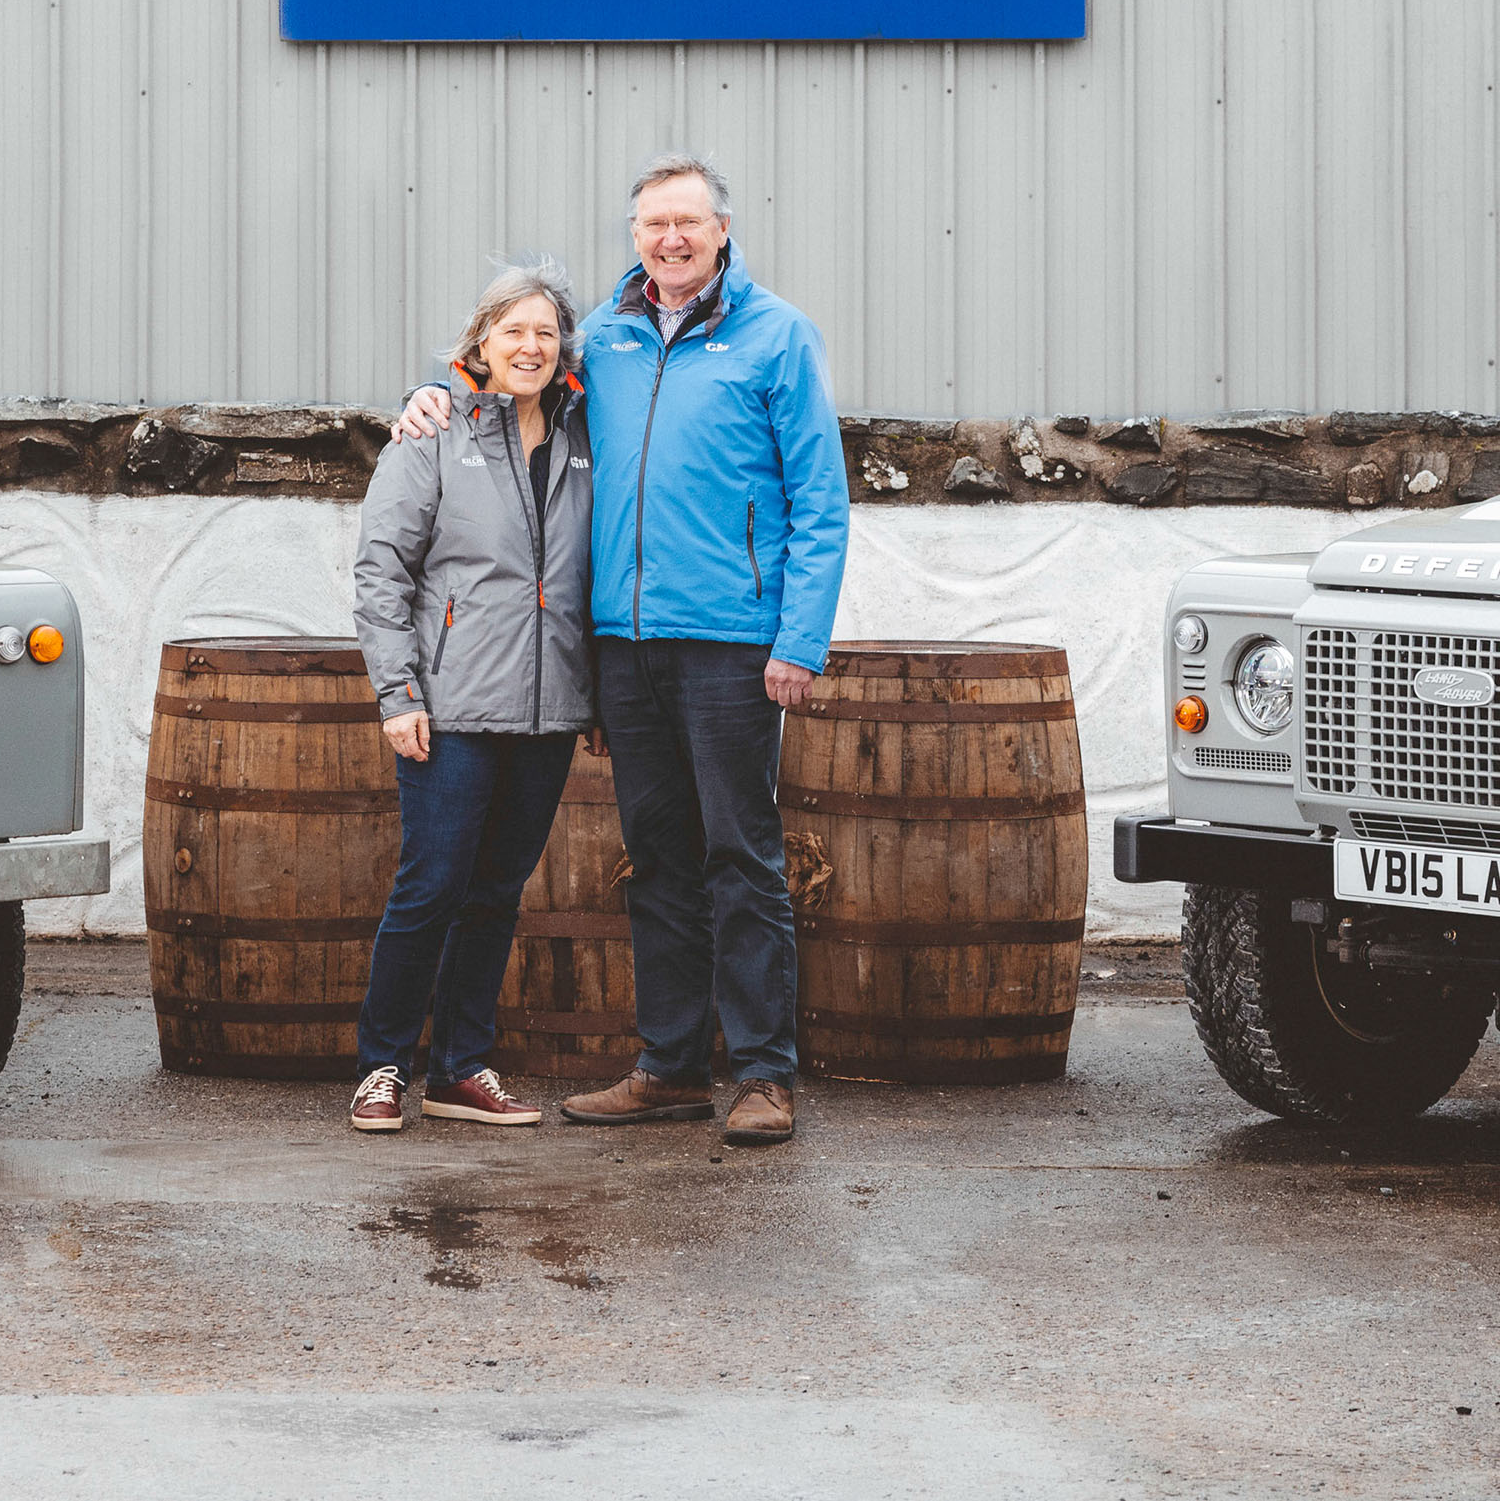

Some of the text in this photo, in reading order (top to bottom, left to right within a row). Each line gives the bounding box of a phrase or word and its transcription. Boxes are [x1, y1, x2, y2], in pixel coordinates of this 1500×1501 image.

[1424, 672, 1457, 684] LAND
[1442, 688, 1483, 701] ROVER
[1360, 847, 1444, 898] VB15
